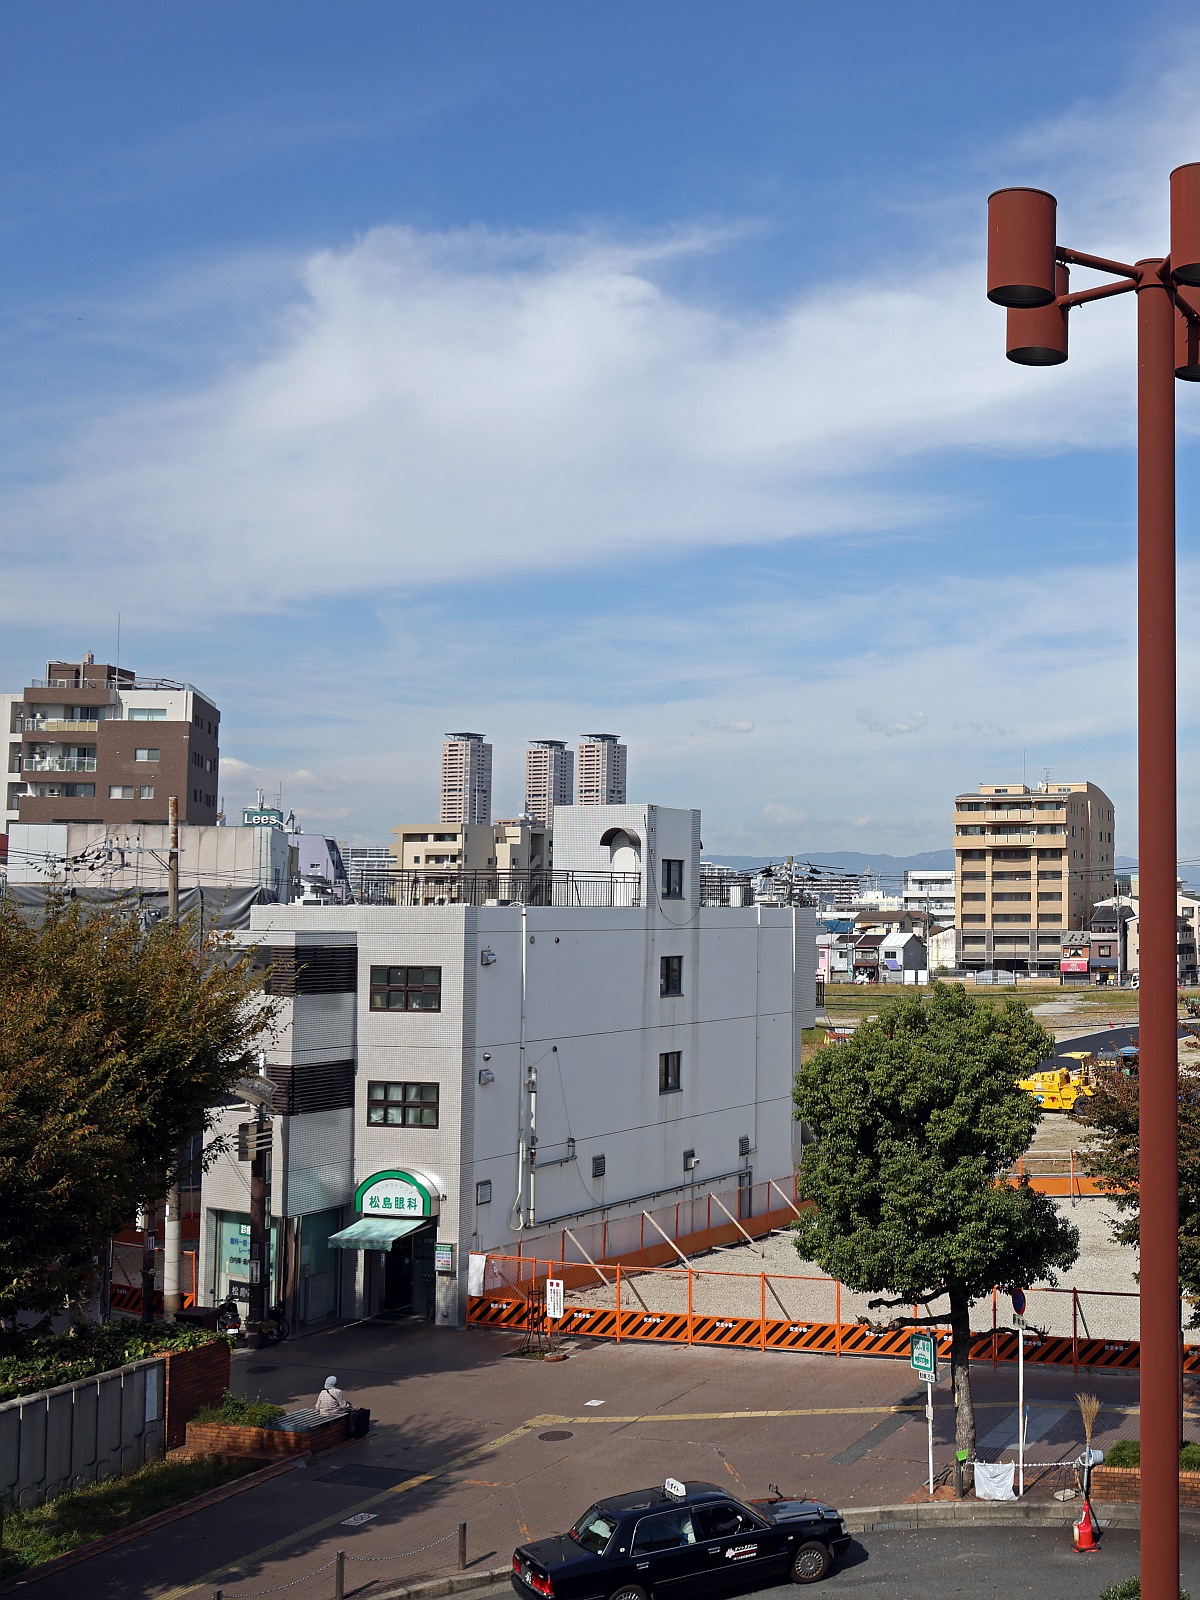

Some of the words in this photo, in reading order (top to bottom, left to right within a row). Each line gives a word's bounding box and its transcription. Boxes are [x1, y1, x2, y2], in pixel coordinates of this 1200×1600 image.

[244, 813, 277, 824] Lees
[368, 1195, 418, 1210] 松島眼科
